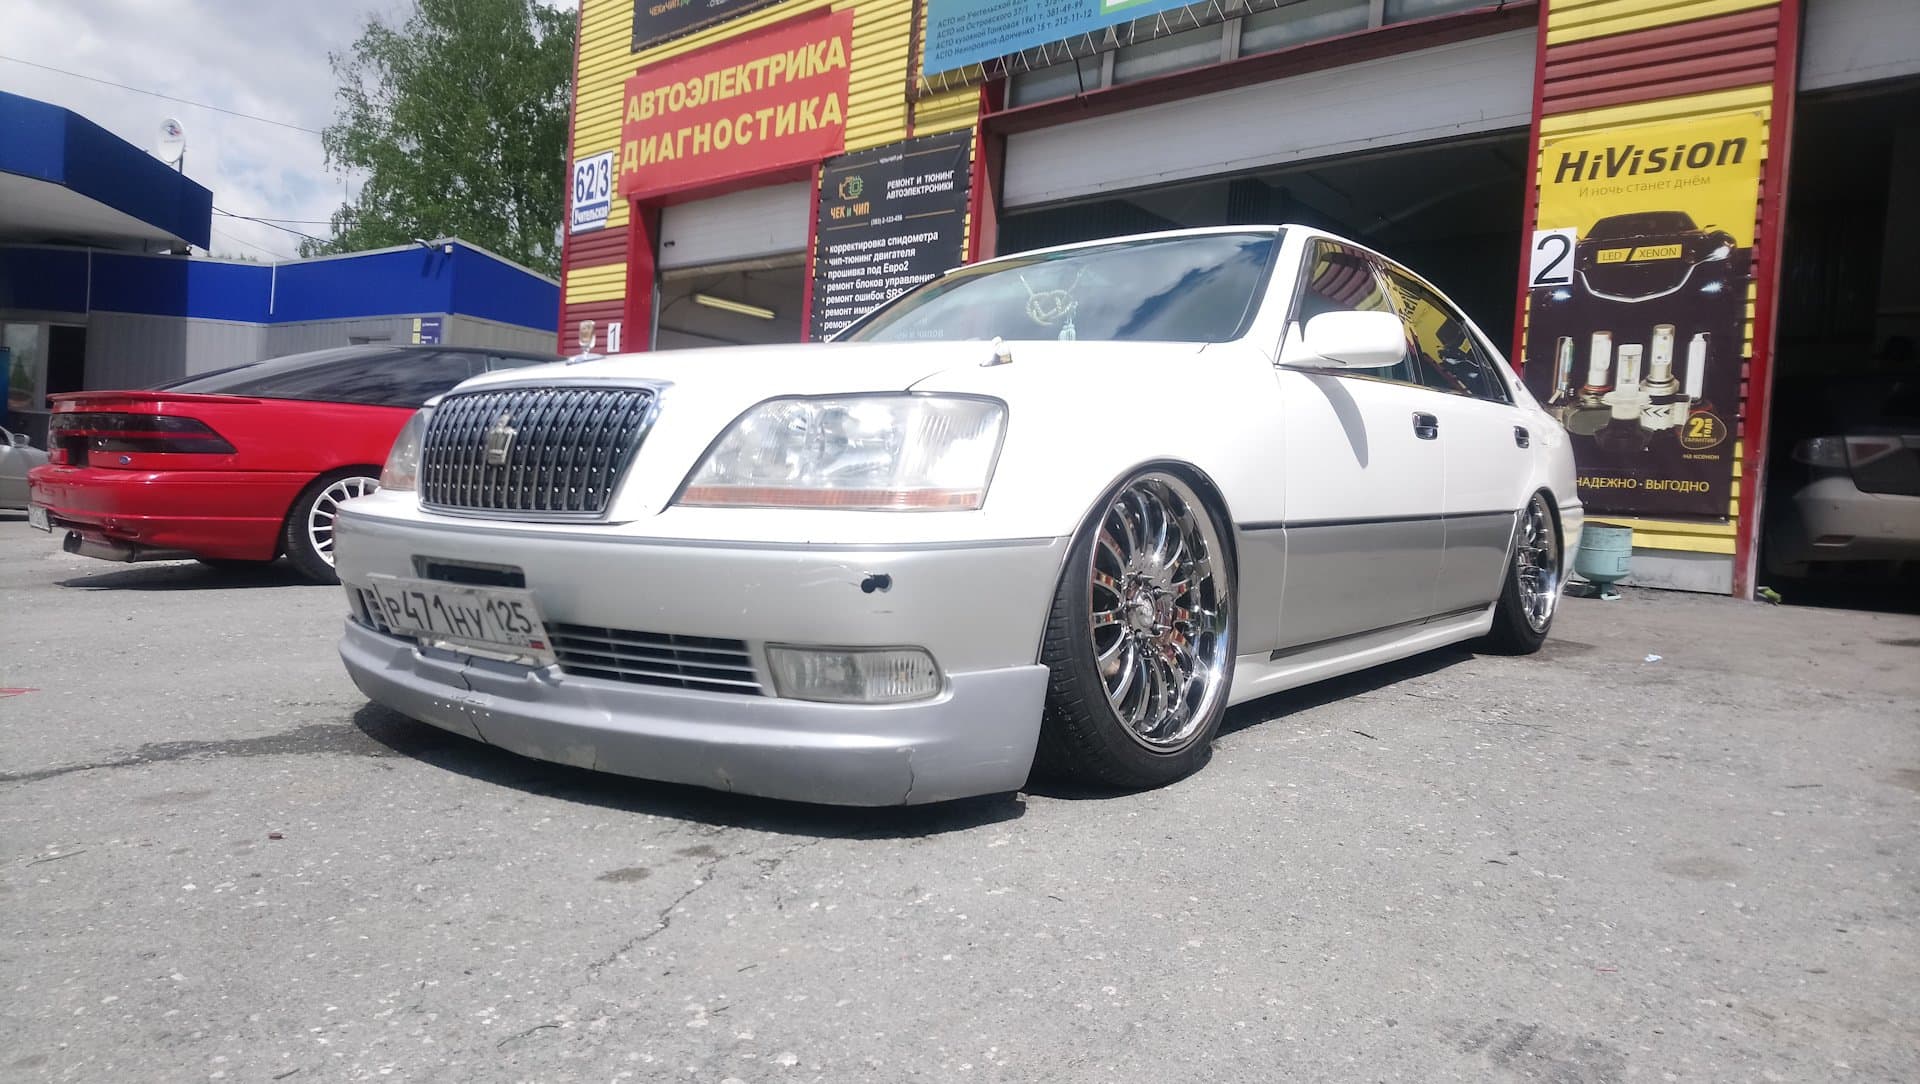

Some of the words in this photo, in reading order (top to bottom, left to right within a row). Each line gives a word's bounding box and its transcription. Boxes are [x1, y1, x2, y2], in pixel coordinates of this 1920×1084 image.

[625, 36, 847, 125] АВТОЭЛЕКТРИКА
[621, 92, 843, 176] ДИАГНОСТИКА
[1554, 137, 1748, 184] HiVision
[576, 159, 609, 203] 62/3
[887, 177, 913, 190] РЕМОНТ
[916, 175, 922, 185] И
[925, 170, 954, 183] ТЮНИНГ
[1579, 187, 1588, 198] И
[1591, 186, 1623, 197] ночь
[1627, 181, 1671, 193] станет
[1674, 175, 1711, 189] днём
[886, 181, 953, 200] АВТОЭЛЕКТРОНИКИ
[831, 206, 845, 220] ЧЕК
[853, 201, 870, 216] ЧИП
[829, 239, 886, 254] корректировка
[887, 231, 938, 246] спидометра
[829, 253, 872, 266] чип-тюнинг
[873, 248, 916, 262] двигателя
[1533, 234, 1571, 285] 2
[1602, 252, 1622, 261] LED
[1639, 247, 1677, 258] XENON
[827, 267, 865, 280] прошивка
[867, 265, 882, 276] под
[883, 261, 909, 274] Евро2
[827, 281, 853, 293] ремонт
[855, 278, 883, 289] блоков
[825, 294, 852, 306] ремонт
[854, 290, 884, 302] ошибок
[886, 288, 904, 299] SRS
[825, 307, 852, 319] ремонт
[610, 325, 617, 350] 1
[1689, 417, 1704, 437] 2
[1576, 477, 1637, 489] НАДЕЖНО
[1645, 479, 1710, 493] ВЫГОДНО
[486, 597, 532, 634] 125
